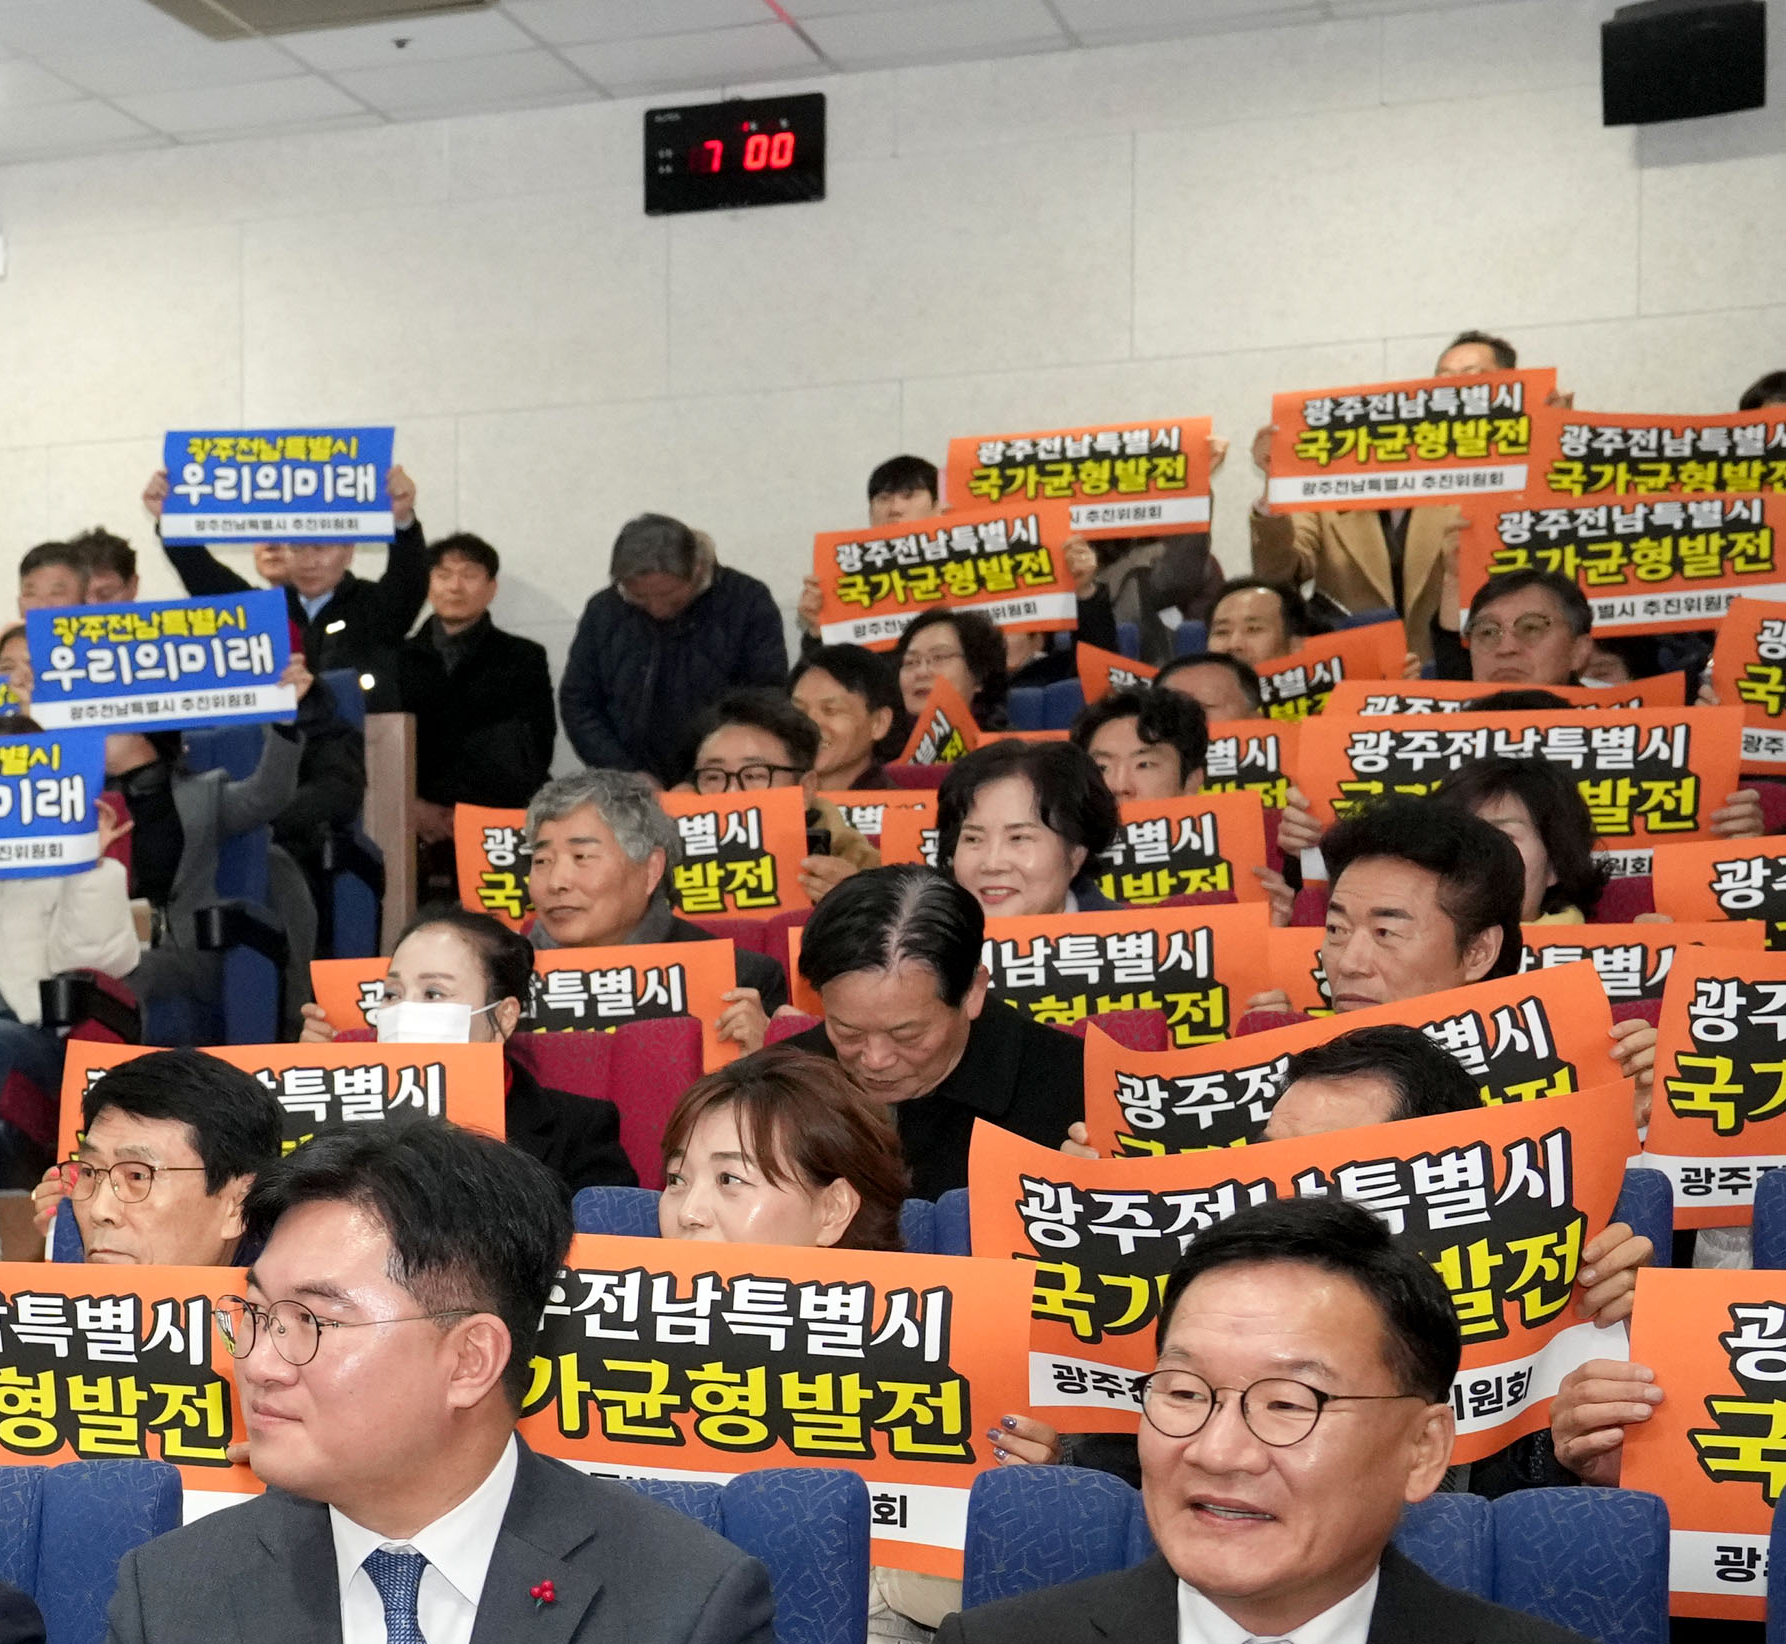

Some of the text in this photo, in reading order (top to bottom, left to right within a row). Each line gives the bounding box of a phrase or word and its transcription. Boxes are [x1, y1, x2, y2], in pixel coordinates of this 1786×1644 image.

[703, 139, 724, 173] 7
[743, 131, 796, 172] 00
[1303, 381, 1524, 427] 광주전남특별시
[187, 436, 358, 463] 광주전남특별시
[977, 426, 1181, 466] 광주전남특별시
[1294, 415, 1529, 466] 국가균형발전
[174, 463, 376, 505] 우리의미래
[968, 454, 1189, 501] 국가균형발전
[836, 514, 1039, 574] 광주전남특별시
[1495, 498, 1763, 545] 광주전남특별시
[837, 547, 1055, 609] 국가균형발전
[53, 606, 246, 645] 광주전남특별시
[41, 633, 274, 691] 우리의미래
[982, 926, 1212, 989] 남특별시
[521, 1352, 971, 1458] 가균형발전
